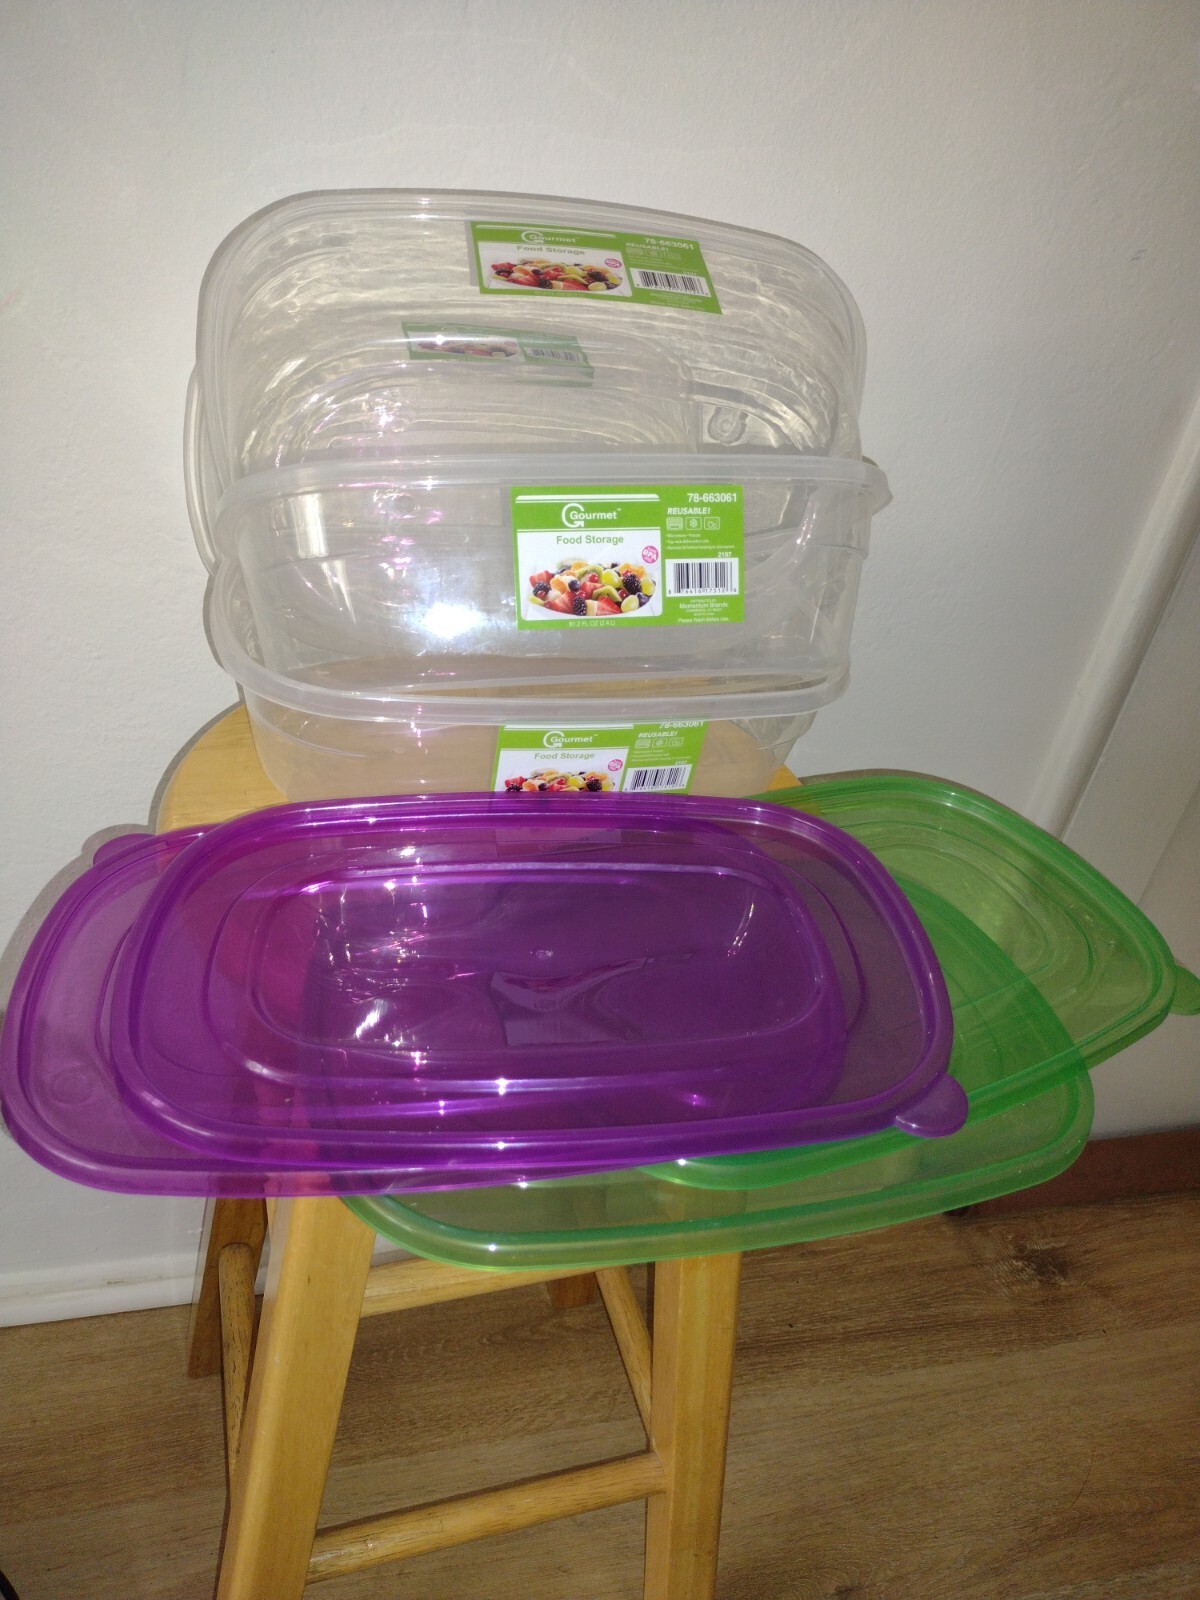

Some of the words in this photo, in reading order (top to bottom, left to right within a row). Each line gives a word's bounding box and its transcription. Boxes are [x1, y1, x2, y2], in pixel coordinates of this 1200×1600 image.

[546, 247, 586, 256] Storage
[687, 492, 737, 503] 78-663061
[667, 507, 711, 515] REUSABLE!
[556, 535, 582, 545] Food
[585, 534, 624, 546] Storage
[560, 752, 595, 760] Storage
